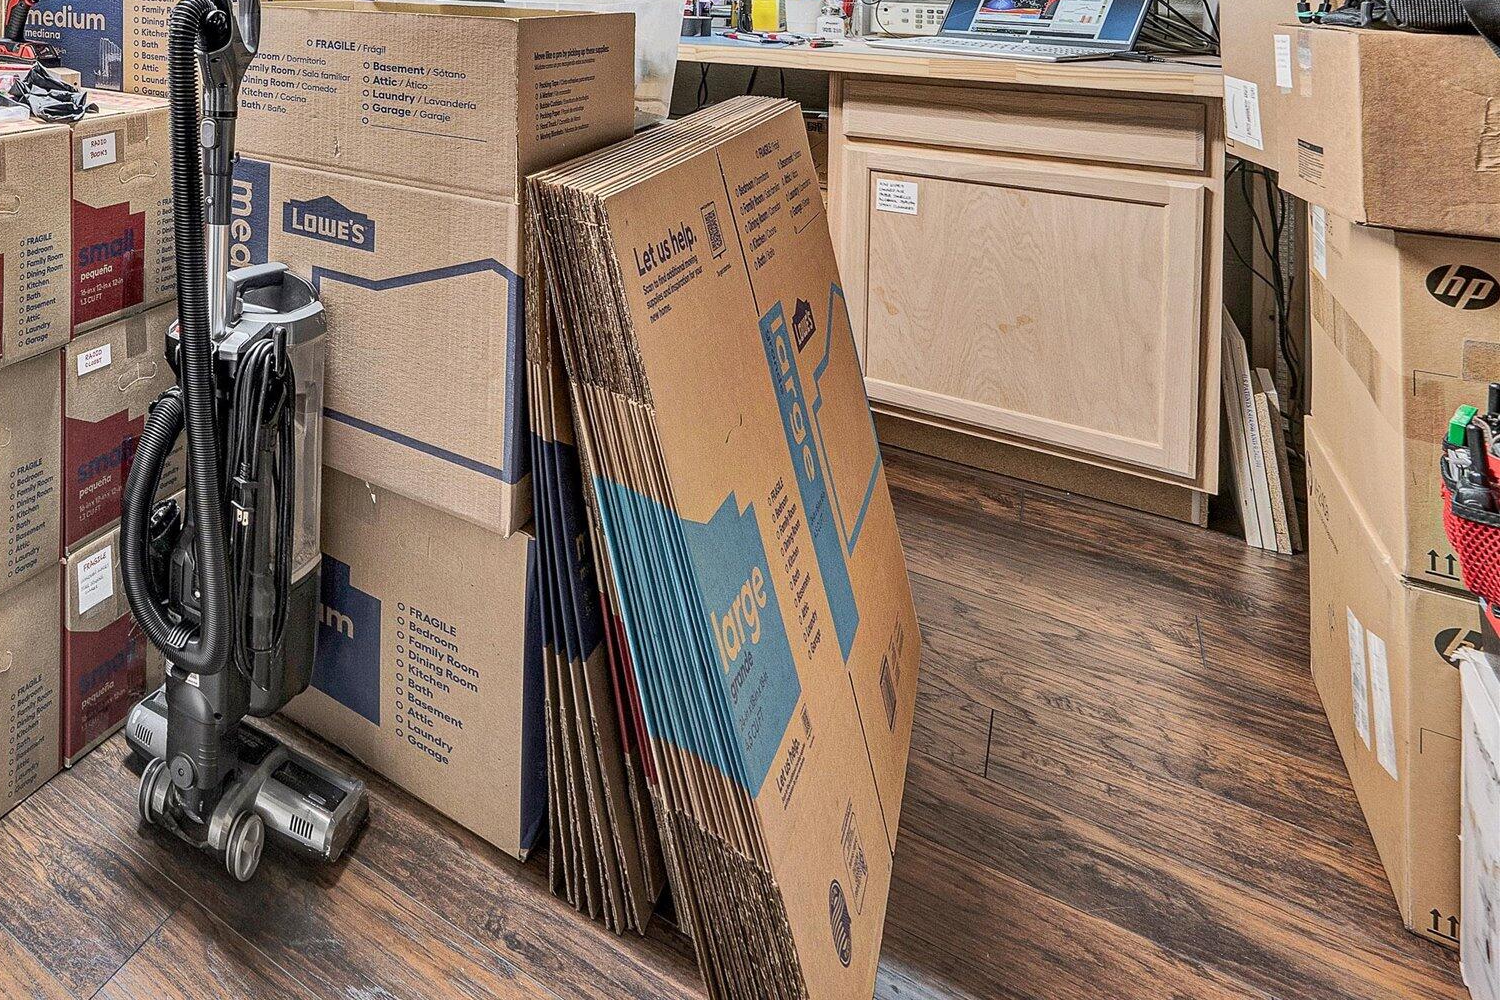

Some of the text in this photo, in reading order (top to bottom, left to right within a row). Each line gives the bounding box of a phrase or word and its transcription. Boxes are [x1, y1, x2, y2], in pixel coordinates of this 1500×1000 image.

[141, 6, 165, 15] Family
[141, 17, 165, 26] Dining
[141, 40, 158, 49] Bath
[316, 39, 386, 55] FRAGILE Frágil
[142, 64, 159, 72] Attic
[287, 54, 326, 65] Dormitorio
[248, 65, 350, 81] amily Room Sala familiar
[373, 62, 466, 79] Basement Sótano
[242, 75, 337, 93] Dining Room Comedor
[373, 75, 428, 90] Attic Ático
[242, 87, 307, 103] Kitchen Cocina
[372, 89, 476, 110] Laundry Lavandería
[241, 100, 286, 114] Bath Baño
[372, 103, 451, 122] Garage Garaje
[292, 207, 365, 244] LOWE'S
[26, 232, 52, 245] FRAGILE
[79, 228, 133, 267] small
[26, 244, 53, 257] Bedroom
[633, 222, 697, 277] Let us help.
[26, 252, 63, 268] Family Room
[26, 263, 63, 279] Dining Room
[80, 264, 112, 283] pequeña
[26, 278, 49, 290] Kitchen
[1434, 265, 1496, 310] hp
[26, 291, 41, 301] Bath
[26, 298, 56, 313] Basement
[25, 321, 51, 335] Laundry
[26, 314, 40, 324] Attic
[25, 333, 48, 346] Garage
[771, 316, 815, 484] large
[17, 458, 43, 476] FRAGILE
[16, 475, 54, 499] Family Room
[17, 470, 44, 487] Bedroom
[79, 474, 112, 499] pequeña
[16, 486, 54, 510] Dining Room
[771, 477, 784, 502] FRAGILE
[16, 503, 40, 520] Kitchen
[15, 521, 46, 542] Basement
[16, 519, 31, 531] Bath
[15, 540, 31, 553] Attic
[15, 546, 40, 564] Laundry
[14, 558, 38, 575] Garage
[83, 552, 107, 572] FRAGILE
[409, 606, 457, 637] FRAGILE
[710, 566, 767, 674] large
[409, 621, 459, 653] Bedroom
[408, 636, 479, 678] Family Room
[408, 650, 478, 694] Dining Room
[408, 664, 450, 694] Kitchen
[729, 650, 753, 705] grande
[17, 674, 43, 697] FRAGILE
[408, 679, 434, 699] Bath
[17, 685, 44, 708] Bedroom
[17, 688, 53, 719] Family Room
[16, 700, 53, 729] Dining Room
[407, 692, 463, 730] Basement
[407, 708, 434, 728] Attic
[16, 719, 39, 740] Kitchen
[407, 720, 454, 754] Laundry
[15, 737, 31, 751] Bath
[15, 735, 45, 761] Basement
[407, 735, 449, 765] Garage
[15, 758, 31, 772] Attic
[15, 761, 40, 784] Laundry
[14, 773, 38, 794] Garage
